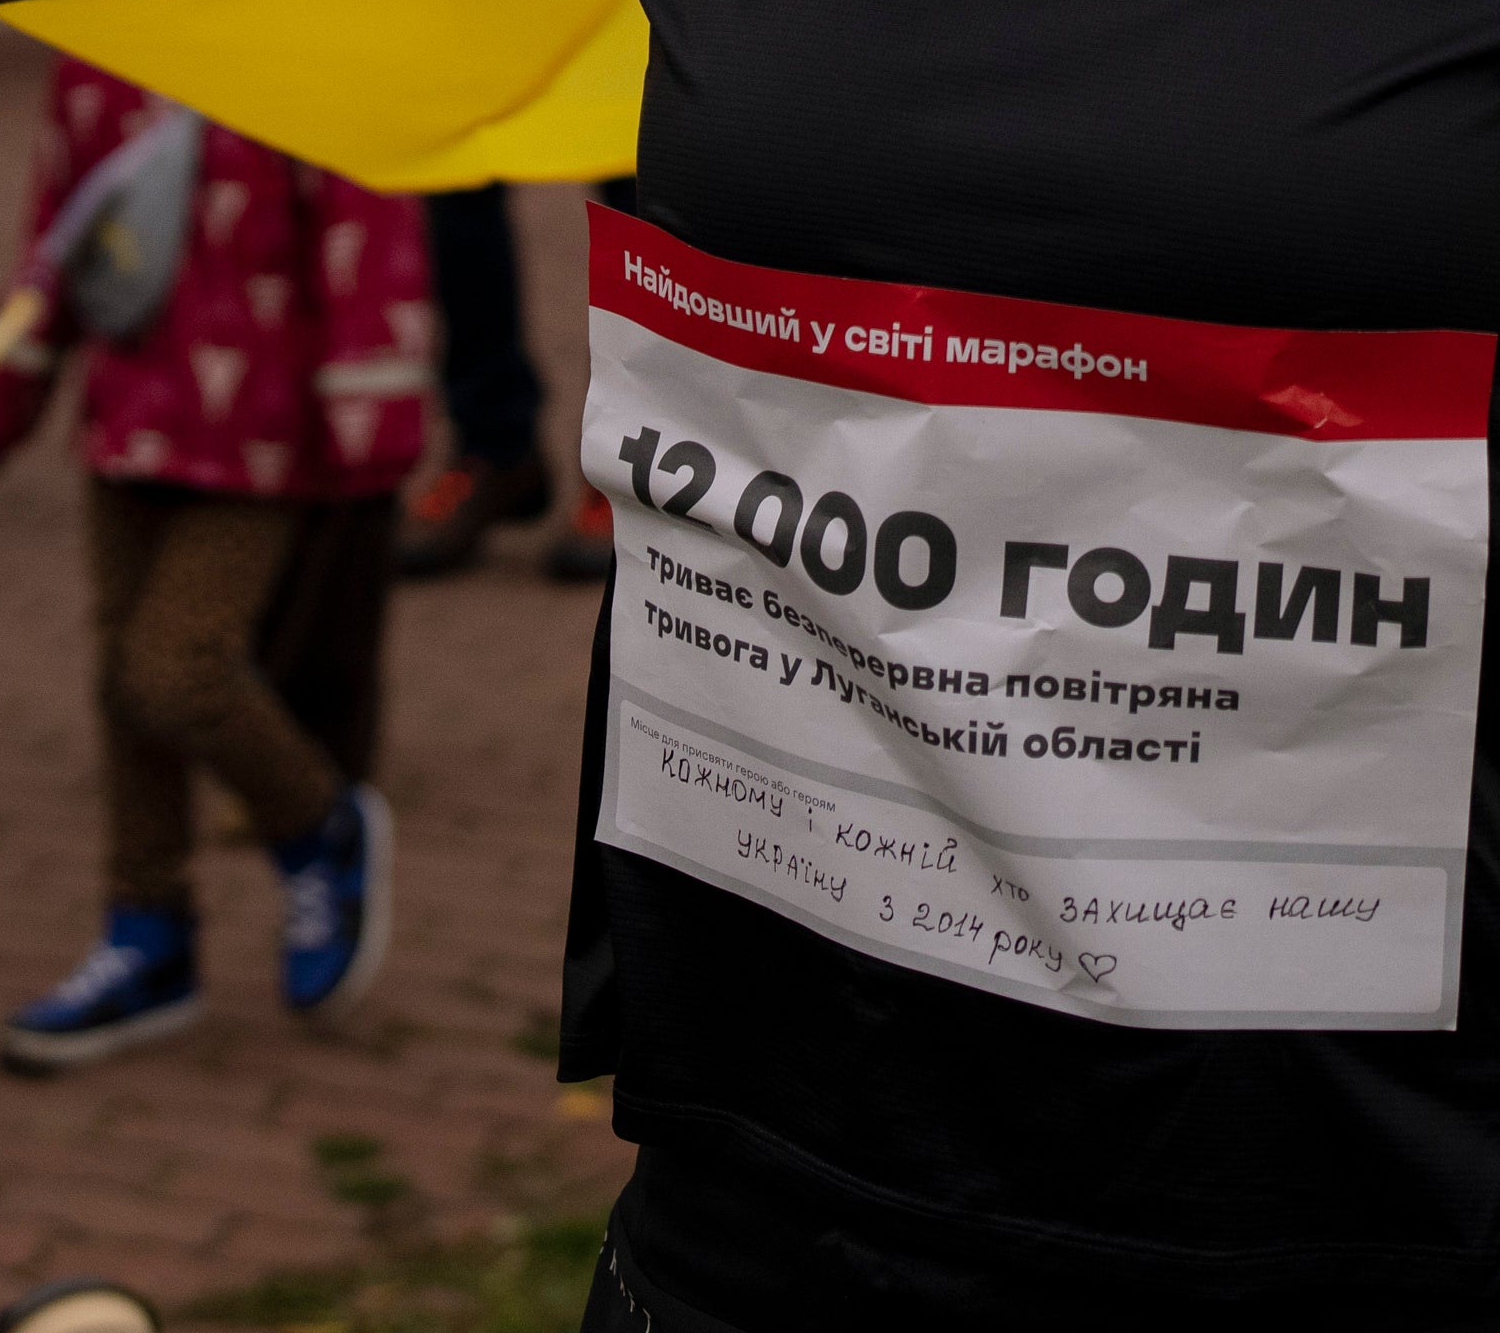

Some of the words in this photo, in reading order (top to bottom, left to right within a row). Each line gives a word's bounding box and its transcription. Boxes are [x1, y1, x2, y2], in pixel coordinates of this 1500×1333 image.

[623, 249, 801, 343] Найдовший
[809, 320, 836, 355] у
[844, 321, 933, 362] світі
[946, 335, 1148, 382] марафон
[618, 425, 724, 538] 12
[733, 469, 958, 612] 000
[1000, 540, 1431, 656] годин
[644, 599, 770, 672] тривога
[779, 652, 803, 687] у
[810, 657, 1009, 759] Луганській
[1022, 725, 1202, 764] області
[646, 545, 754, 610] триває
[762, 589, 991, 698] безперервна
[1005, 669, 1241, 715] повітряна
[629, 715, 660, 741] Місце
[661, 732, 680, 750] для
[682, 743, 734, 772] присвяти
[735, 764, 770, 787] герою
[771, 776, 792, 797] або
[792, 789, 837, 814] героям
[912, 903, 985, 943] 2014
